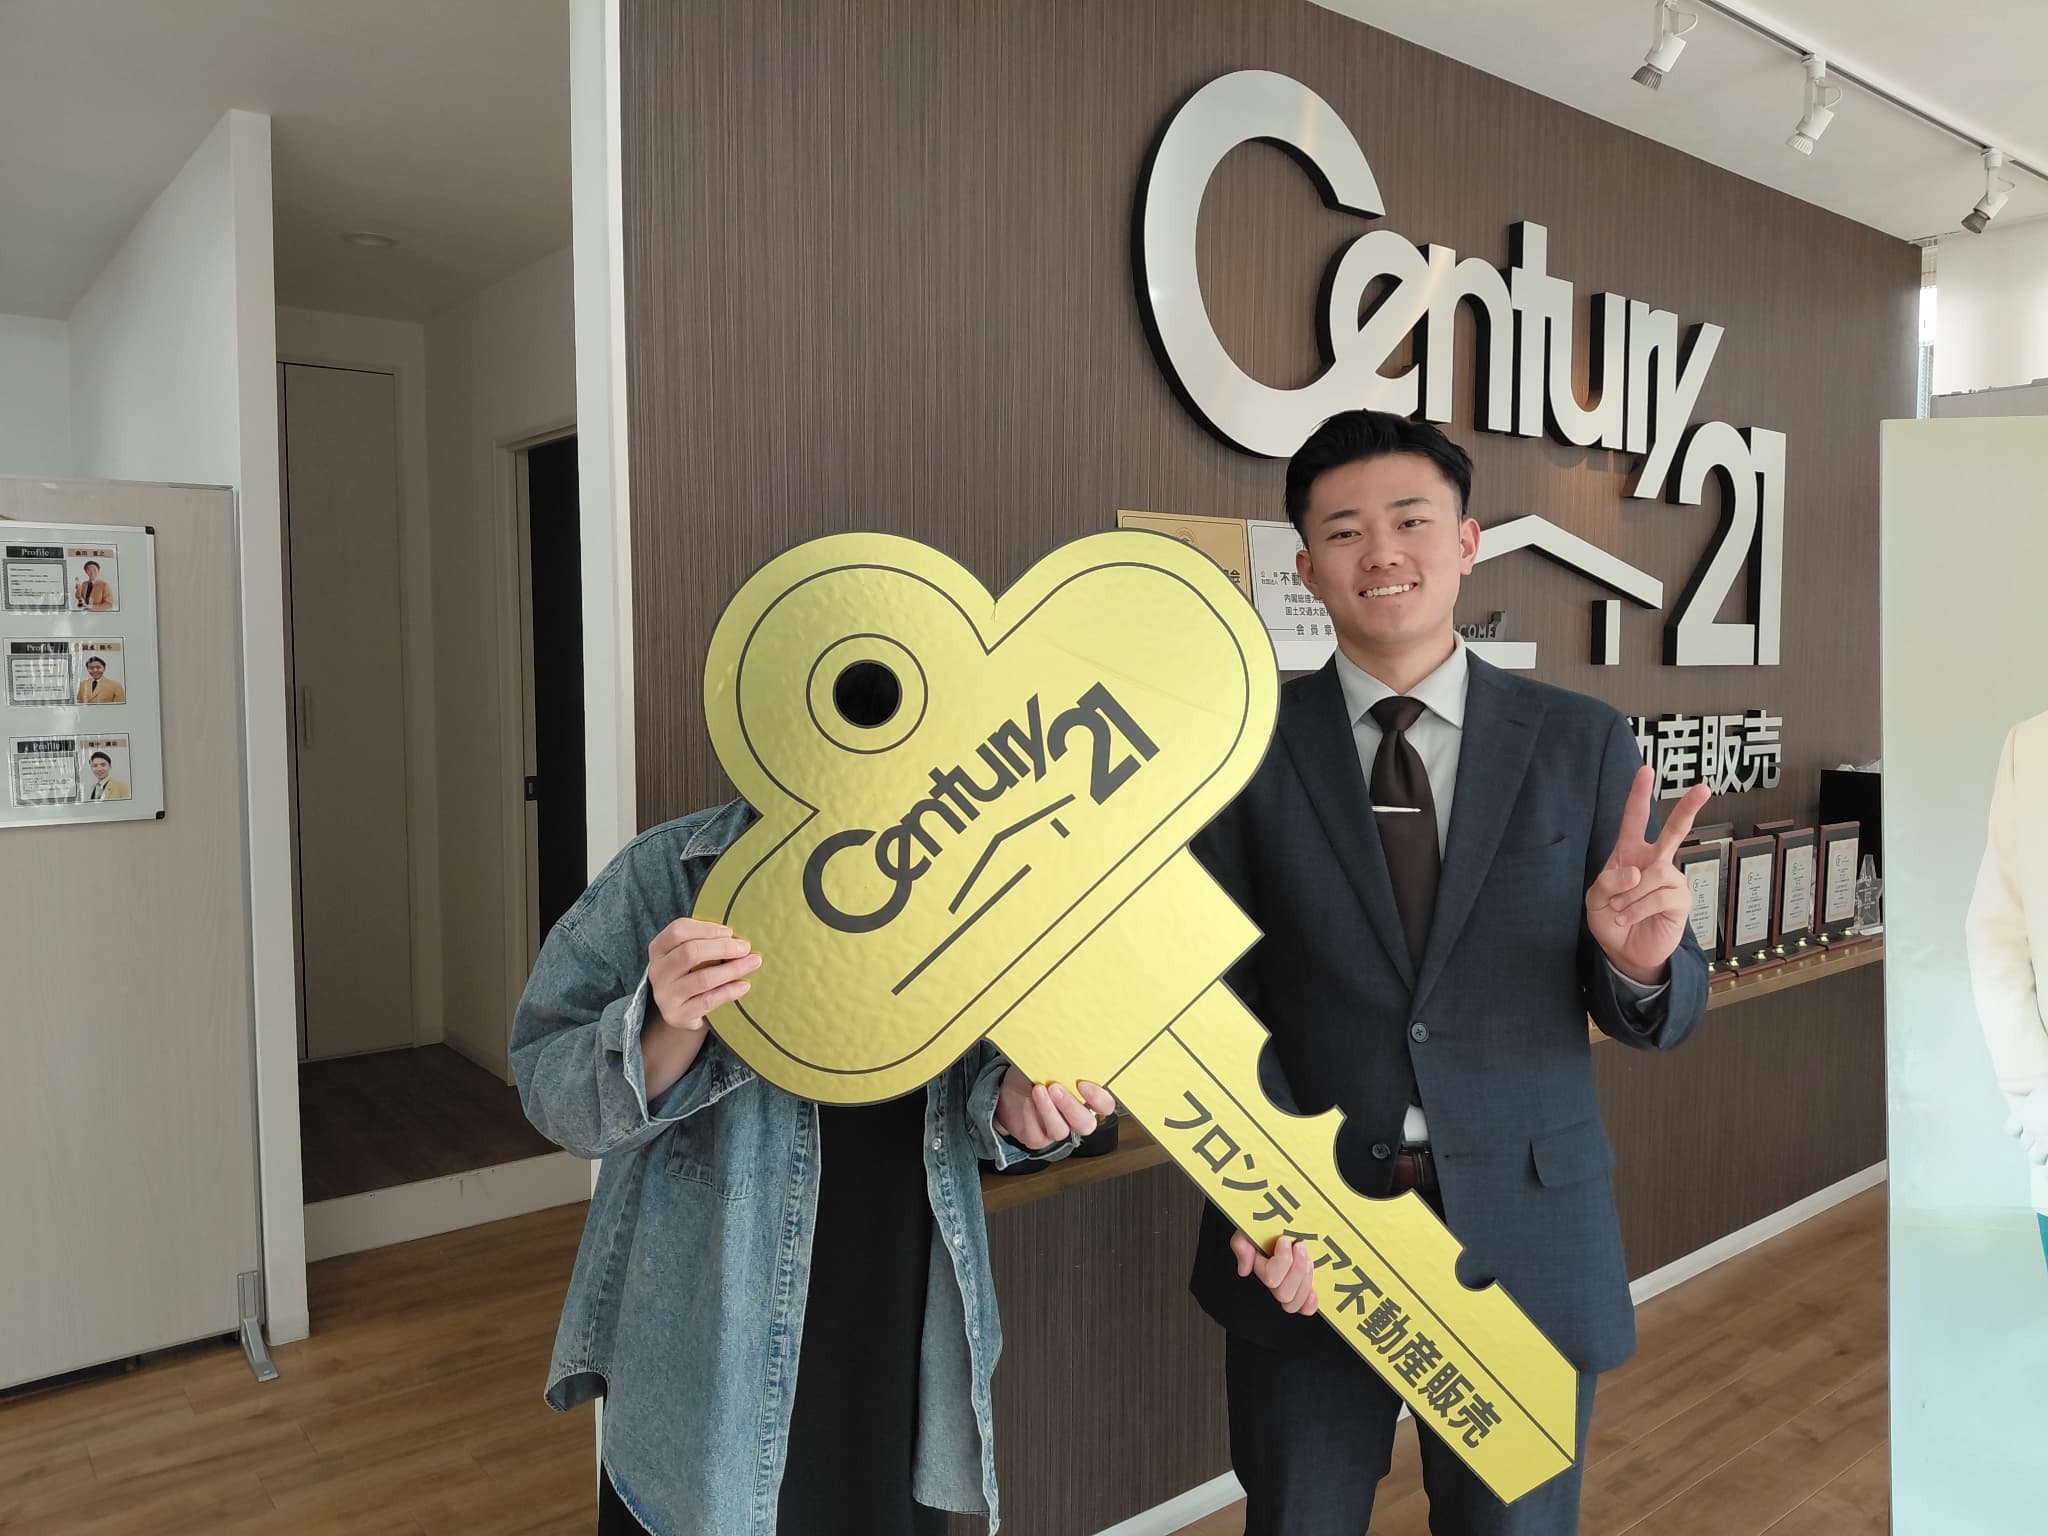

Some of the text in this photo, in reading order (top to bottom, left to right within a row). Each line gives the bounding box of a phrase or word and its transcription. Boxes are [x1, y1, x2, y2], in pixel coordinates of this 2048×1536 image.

[1140, 69, 1787, 666] Century 21
[802, 681, 1161, 934] Century 21
